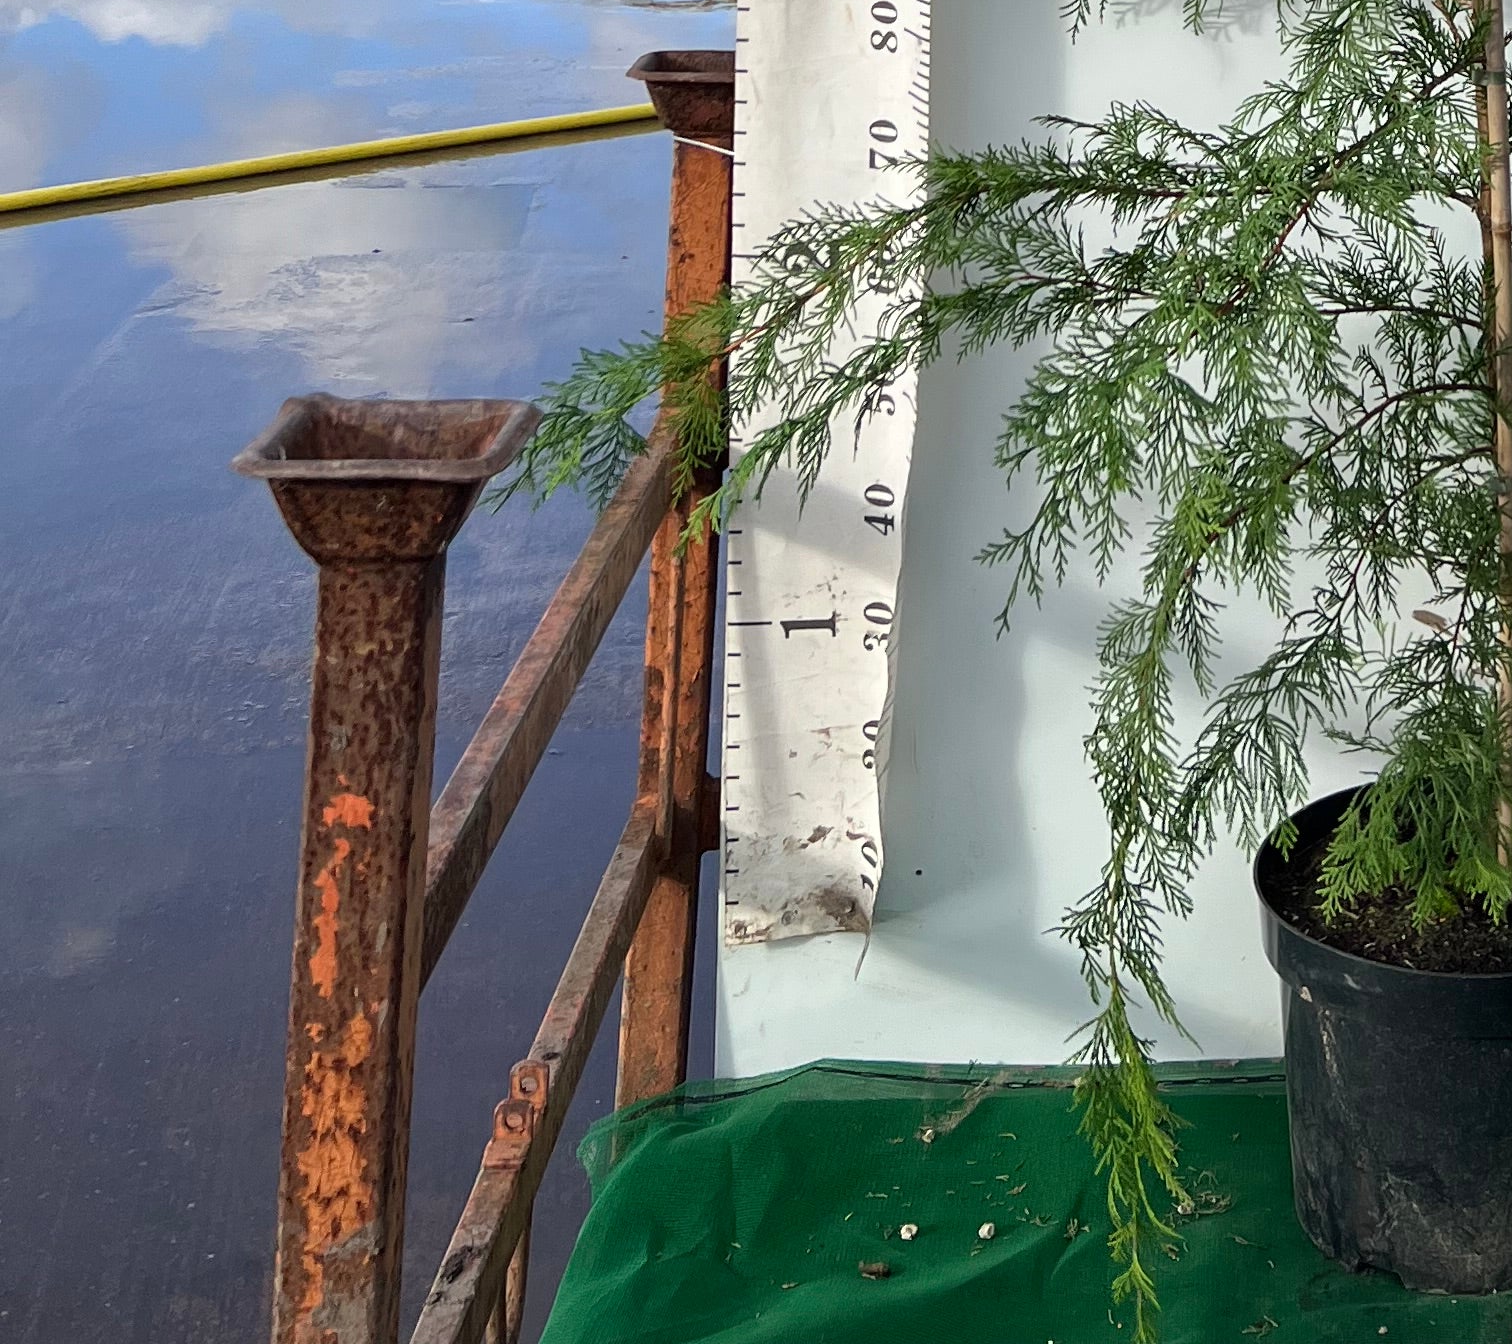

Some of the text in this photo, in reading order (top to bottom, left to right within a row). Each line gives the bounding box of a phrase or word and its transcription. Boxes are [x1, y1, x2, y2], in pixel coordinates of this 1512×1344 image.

[870, 0, 898, 54] 80
[869, 119, 898, 170] 70
[864, 483, 895, 537] 40
[779, 610, 838, 639] 1
[863, 601, 894, 652] 30
